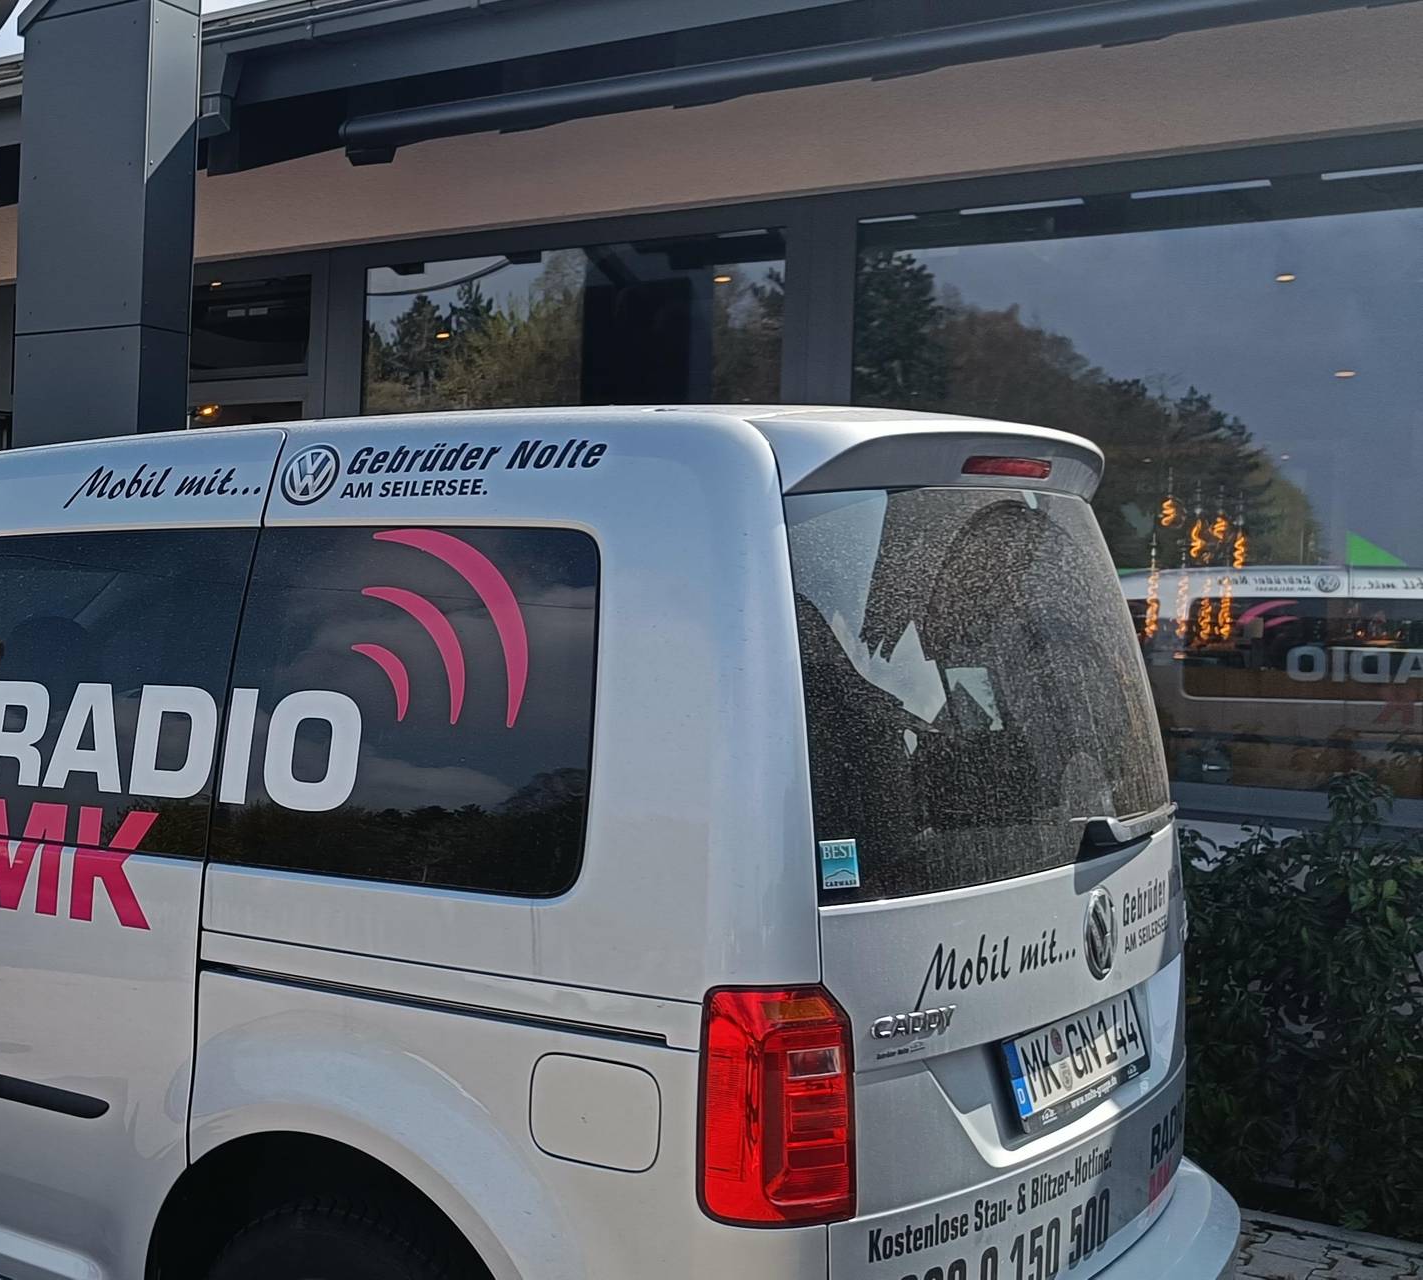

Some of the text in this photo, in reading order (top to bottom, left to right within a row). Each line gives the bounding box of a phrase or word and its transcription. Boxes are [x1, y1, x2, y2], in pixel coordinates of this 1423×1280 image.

[346, 438, 608, 475] Gebrüder Nolte
[63, 463, 262, 509] Mobil mit...
[340, 478, 488, 499] AM SEILERSEE.
[822, 844, 853, 860] BEST
[1123, 878, 1166, 927] Gebrüder
[1124, 932, 1137, 954] AM
[914, 928, 1076, 1011] Mobil mit...
[871, 1004, 957, 1039] CADDY
[1020, 1034, 1062, 1103] MK
[868, 1147, 1113, 1263] Kostenlose Stau- & Blitzer-Hotline:
[1068, 1188, 1110, 1262] 500
